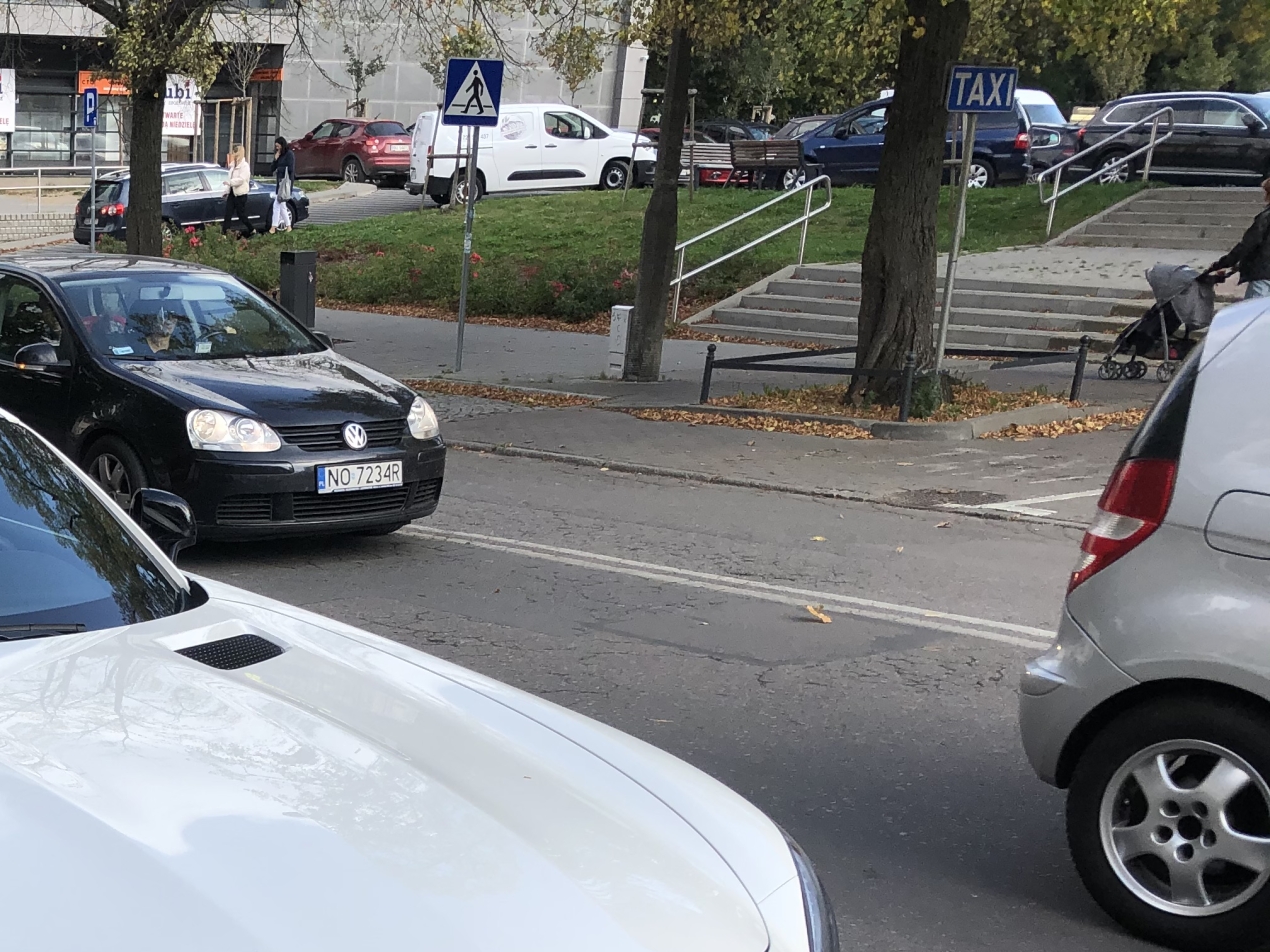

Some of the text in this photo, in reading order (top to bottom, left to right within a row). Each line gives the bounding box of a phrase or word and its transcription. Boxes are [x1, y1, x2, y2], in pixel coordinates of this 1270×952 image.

[165, 80, 192, 99] ubi
[955, 72, 1015, 107] TAXI
[328, 467, 351, 488] NO
[356, 463, 400, 485] 7234R
